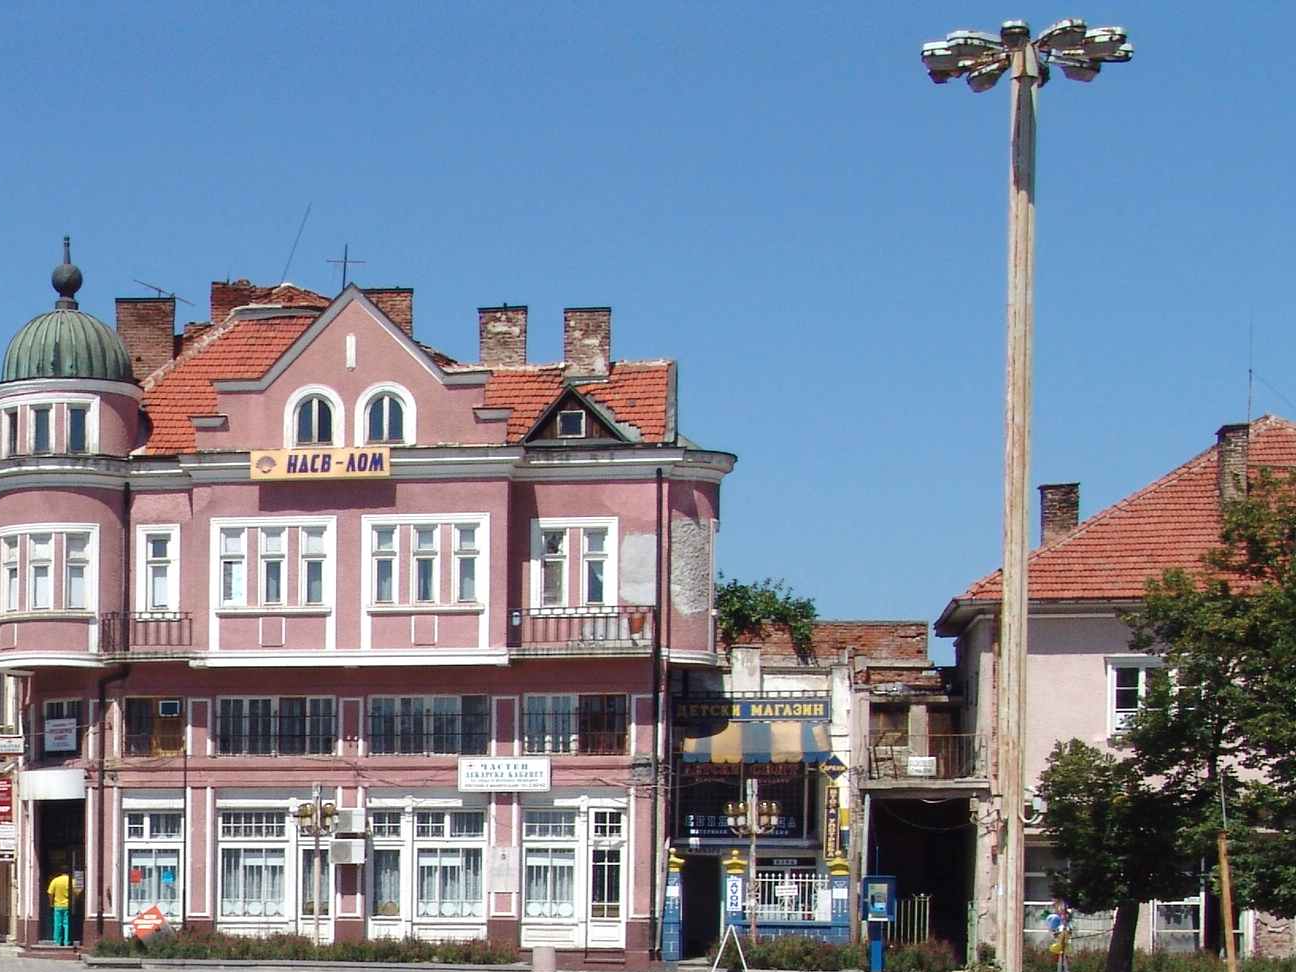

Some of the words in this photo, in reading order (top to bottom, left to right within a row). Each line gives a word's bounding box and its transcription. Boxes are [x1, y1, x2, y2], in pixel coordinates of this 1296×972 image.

[346, 452, 385, 472] ЛОМ
[676, 704, 741, 718] ДЕТСКИ
[751, 703, 825, 717] МАГАЗИН
[729, 882, 740, 907] AVON
